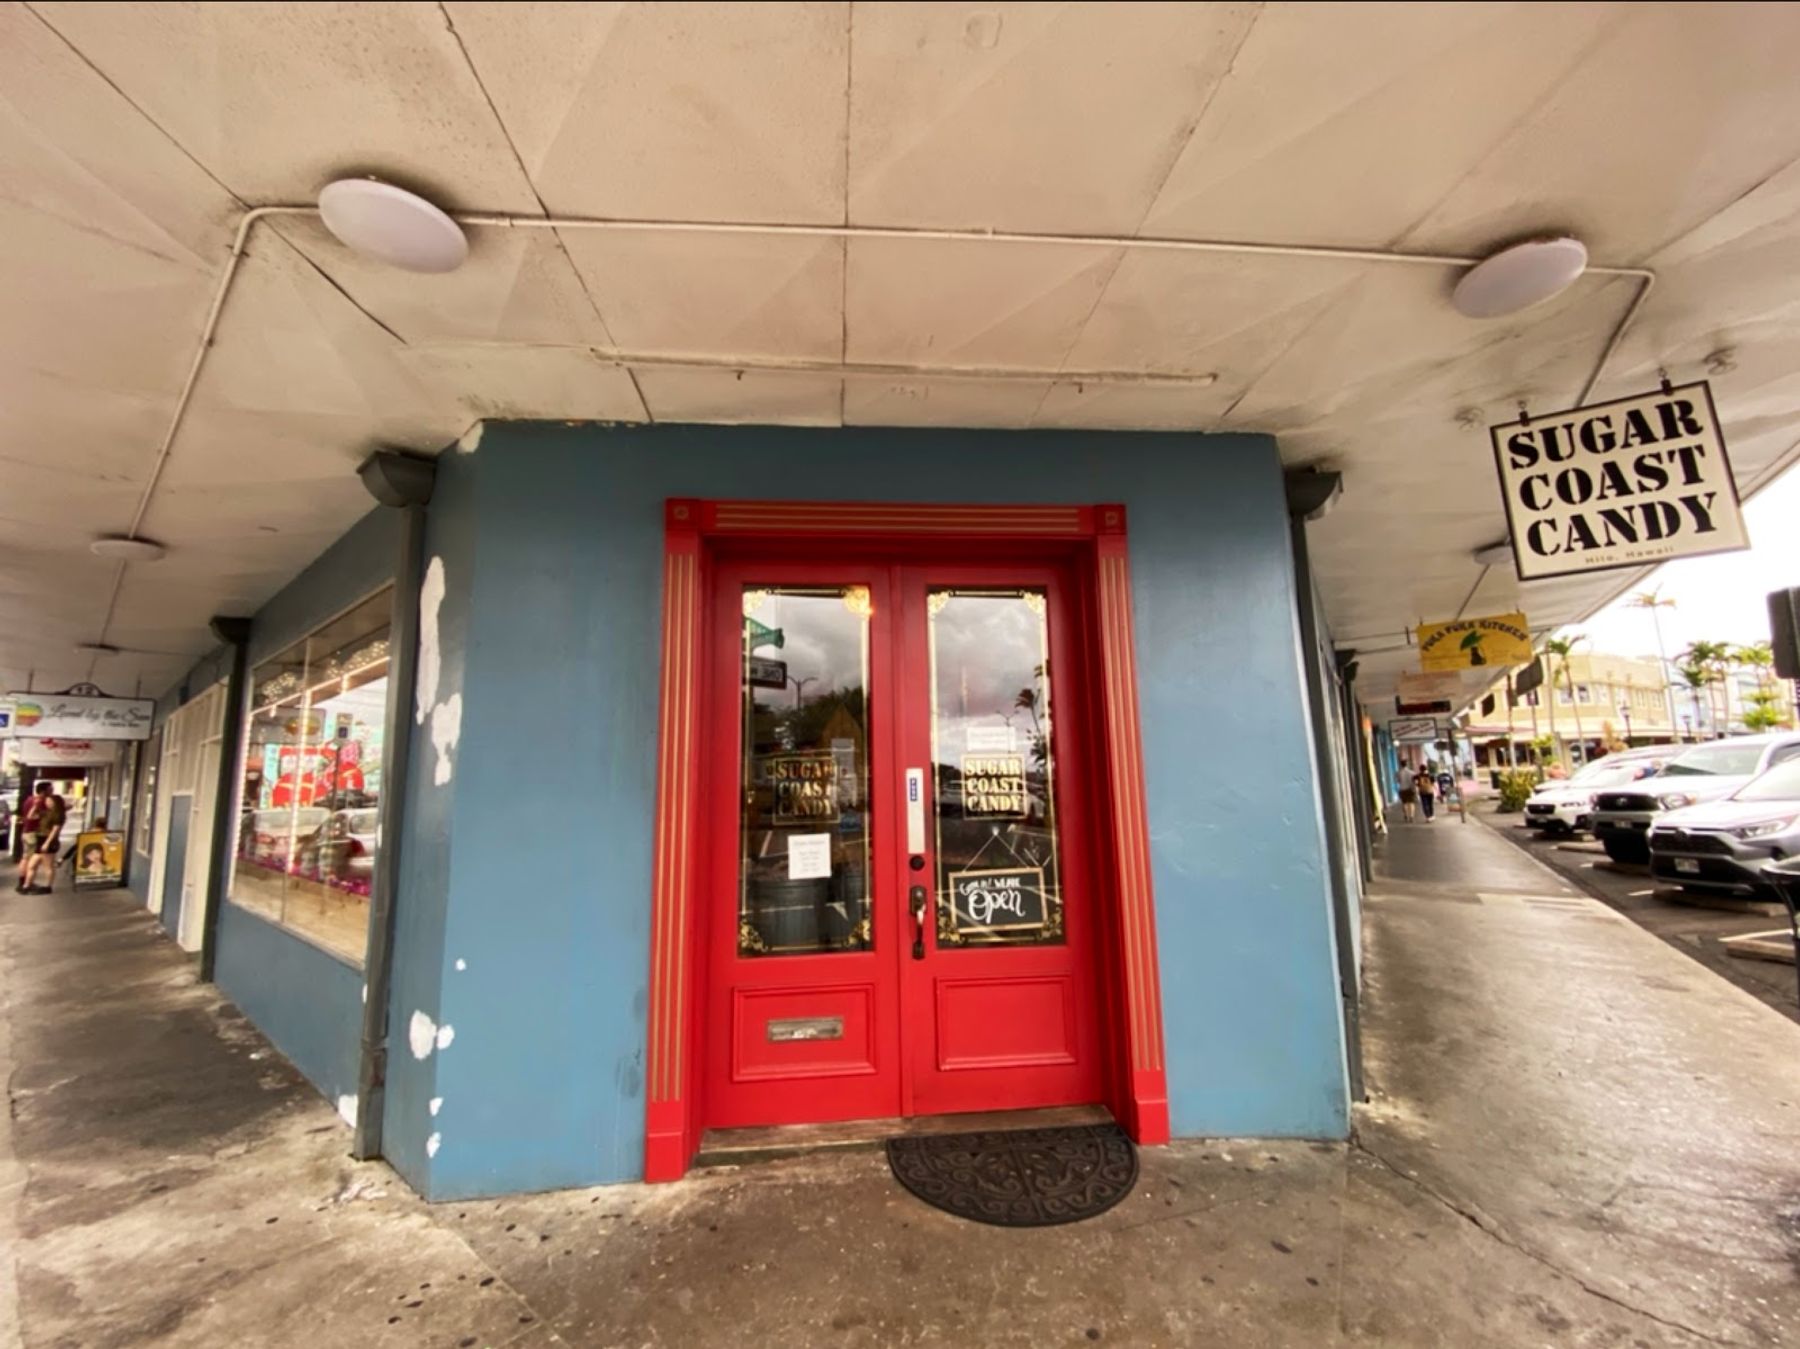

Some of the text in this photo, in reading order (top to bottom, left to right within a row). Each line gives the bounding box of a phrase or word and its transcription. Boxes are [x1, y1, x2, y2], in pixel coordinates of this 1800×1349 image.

[1507, 399, 1704, 470] SUGAR
[1519, 444, 1706, 511] COAST
[1527, 492, 1718, 556] CANDY
[965, 759, 1021, 775] SUGAR
[779, 780, 832, 797] COAST
[966, 777, 1023, 794] COAST
[779, 799, 833, 815] CANDY
[967, 795, 1021, 811] CANDY
[968, 888, 1026, 924] Open
